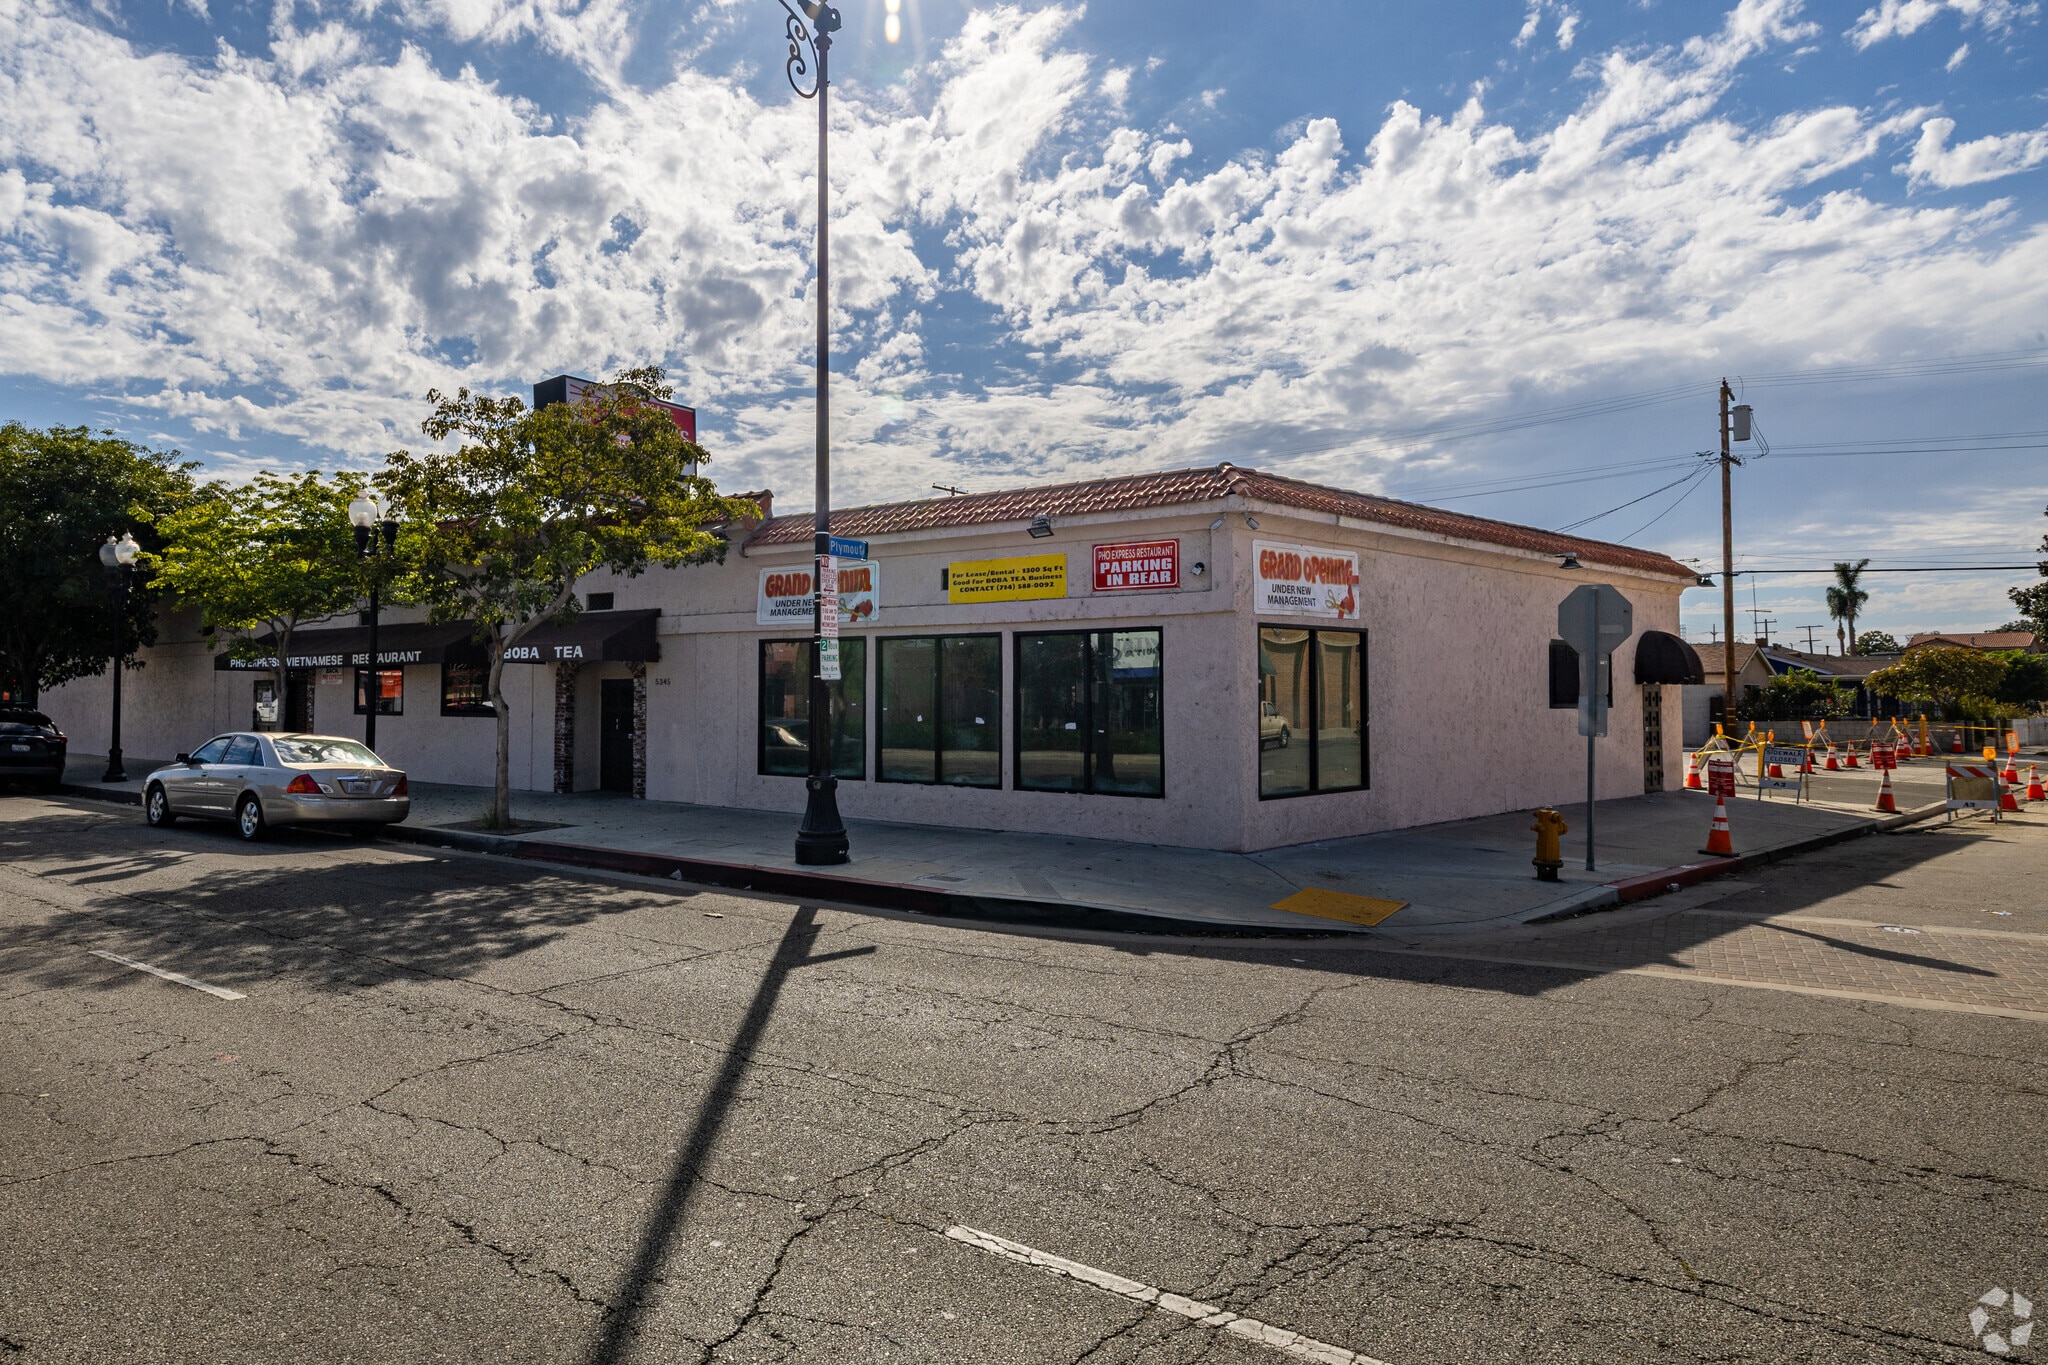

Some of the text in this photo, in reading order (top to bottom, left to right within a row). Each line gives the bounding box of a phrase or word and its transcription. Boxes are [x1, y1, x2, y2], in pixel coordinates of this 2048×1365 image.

[1098, 546, 1174, 560] PHO EXPRESS RESTAURANT
[1100, 558, 1172, 573] PARKING
[966, 569, 1015, 578] Lease/Rental
[1106, 571, 1171, 586] IN REAR
[996, 583, 1015, 591] (714)
[1017, 582, 1055, 590] 588-0092
[1271, 584, 1312, 596] UNDER NEW
[775, 599, 801, 608] UNDER
[1267, 595, 1316, 607] MANAGEMENT
[770, 607, 815, 617] MANAGEME
[822, 640, 827, 650] 2
[503, 645, 584, 659] BOBA TEA
[286, 655, 343, 667] VIETNAMESE
[352, 650, 421, 665] RESAURANT
[821, 654, 838, 662] PARKING
[655, 678, 671, 686] 5345
[1766, 749, 1803, 757] SIDEWALK
